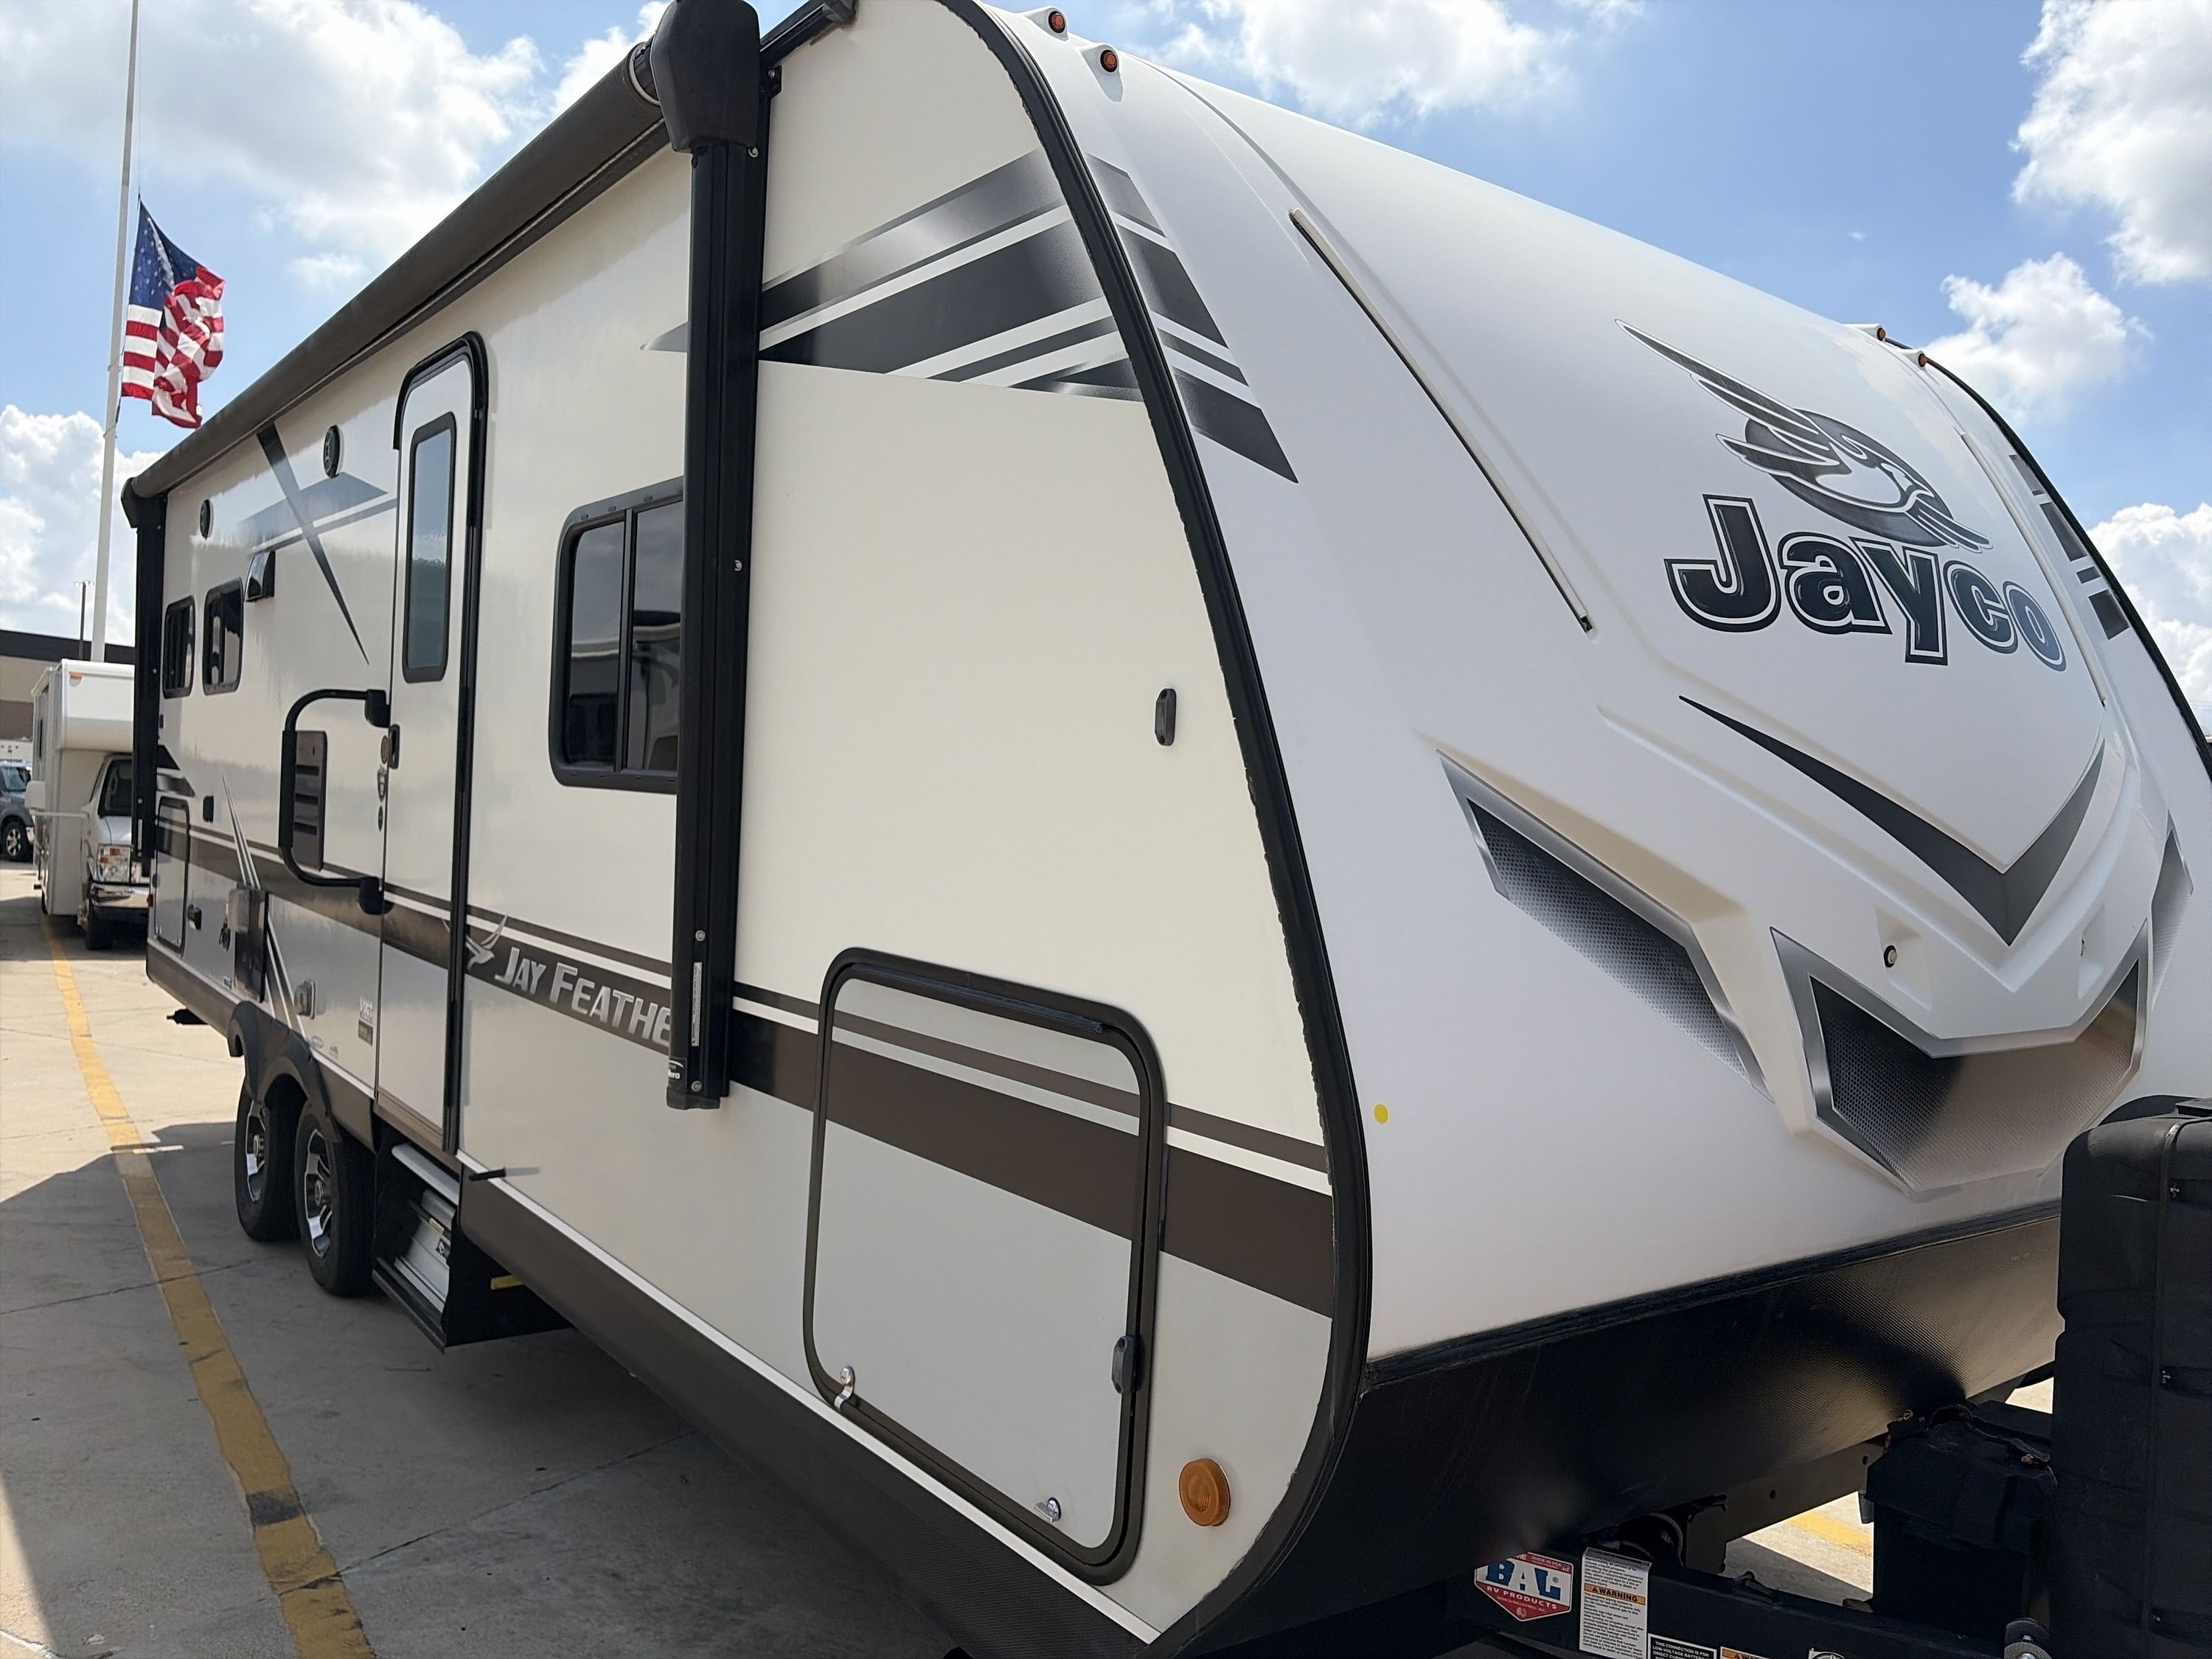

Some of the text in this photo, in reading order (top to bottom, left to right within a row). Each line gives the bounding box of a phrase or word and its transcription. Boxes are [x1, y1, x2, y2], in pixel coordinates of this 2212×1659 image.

[1663, 493, 2066, 672] Jayco
[494, 946, 547, 995] JAY
[549, 961, 672, 1047] FEATHE
[1486, 1559, 1561, 1601] BAL
[1599, 1587, 1638, 1602] WARNING
[1486, 1585, 1557, 1610] RV PRODUCTS
[1666, 1644, 1694, 1654] CONNECTION
